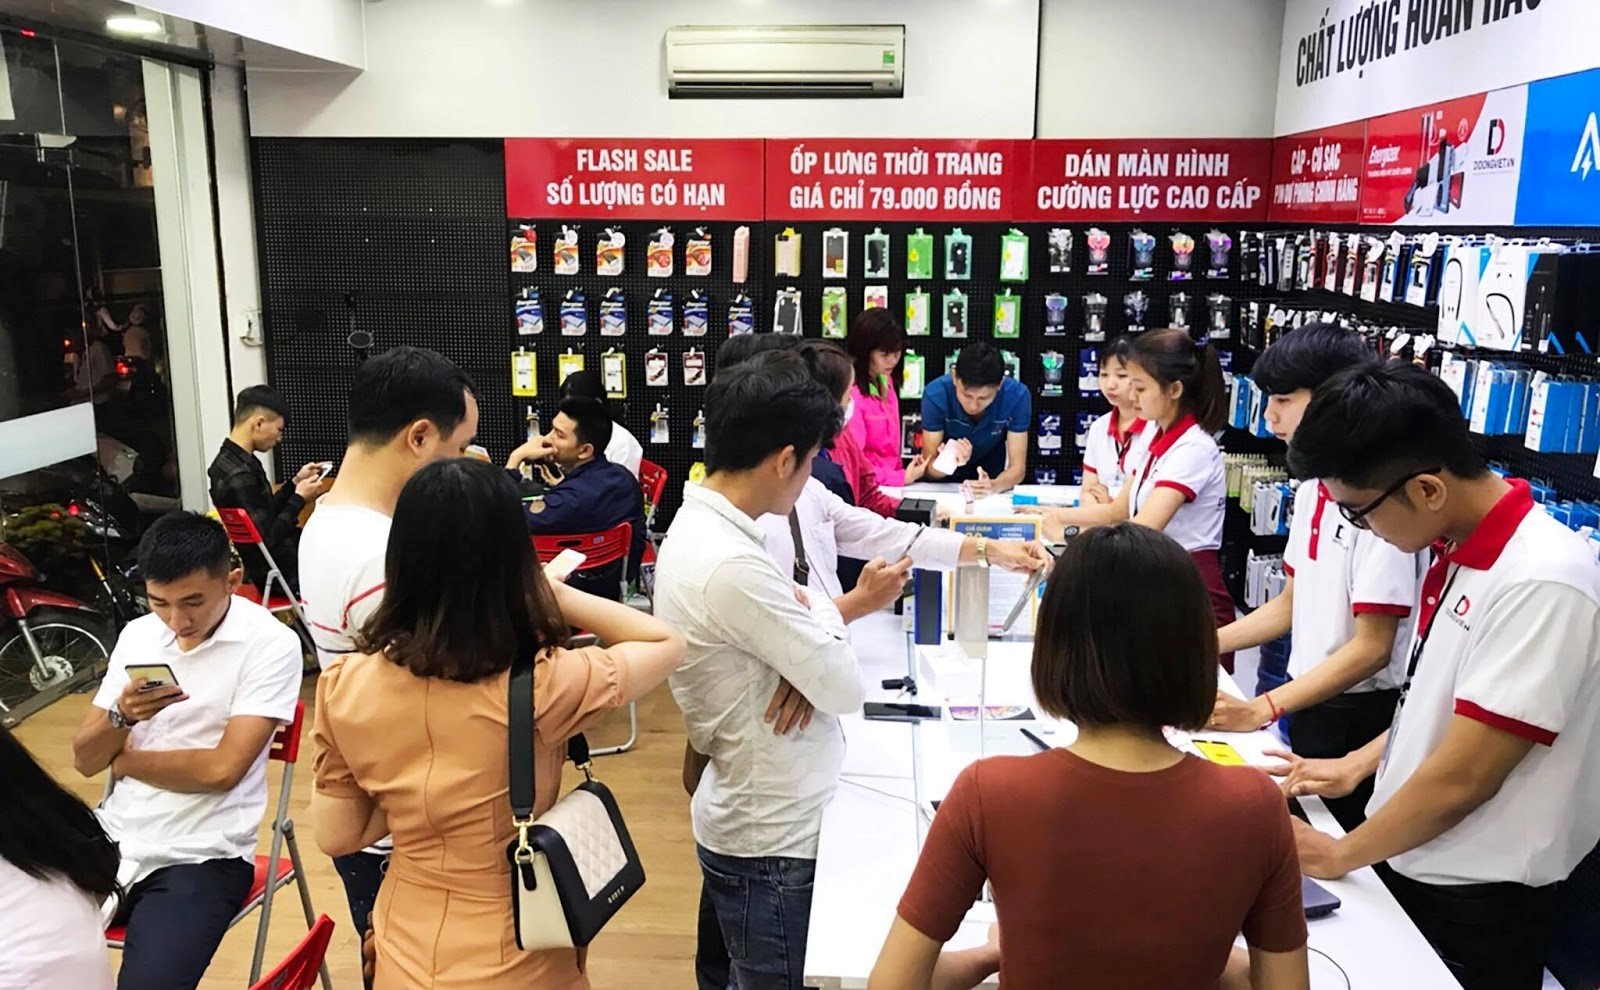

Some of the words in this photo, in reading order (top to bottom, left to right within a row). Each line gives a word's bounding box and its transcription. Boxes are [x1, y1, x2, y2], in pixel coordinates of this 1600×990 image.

[1296, 8, 1336, 87] CHẤT
[1336, 0, 1400, 78] LƯỢNG
[577, 149, 638, 172] FLASH
[644, 149, 693, 172] SALE
[790, 144, 818, 175] ỐP
[823, 150, 877, 175] LƯNG
[883, 146, 929, 175] THỜI
[935, 152, 1003, 175] TRANG
[1065, 148, 1111, 177] DÁN
[1117, 148, 1169, 177] MÀN
[1175, 148, 1229, 177] HÌNH
[547, 175, 574, 206] SỐ
[579, 182, 645, 210] LƯỢNG
[650, 177, 679, 206] CÓ
[683, 184, 725, 211] HẠN
[790, 181, 824, 209] GIÁ
[830, 179, 865, 209] CHỈ
[869, 187, 939, 209] 79.000
[944, 179, 1001, 210] ĐỒNG
[1037, 180, 1112, 209] CƯỜNG
[1118, 183, 1160, 214] LỰC
[1166, 185, 1210, 209] CAO
[1216, 177, 1261, 209] CẤP
